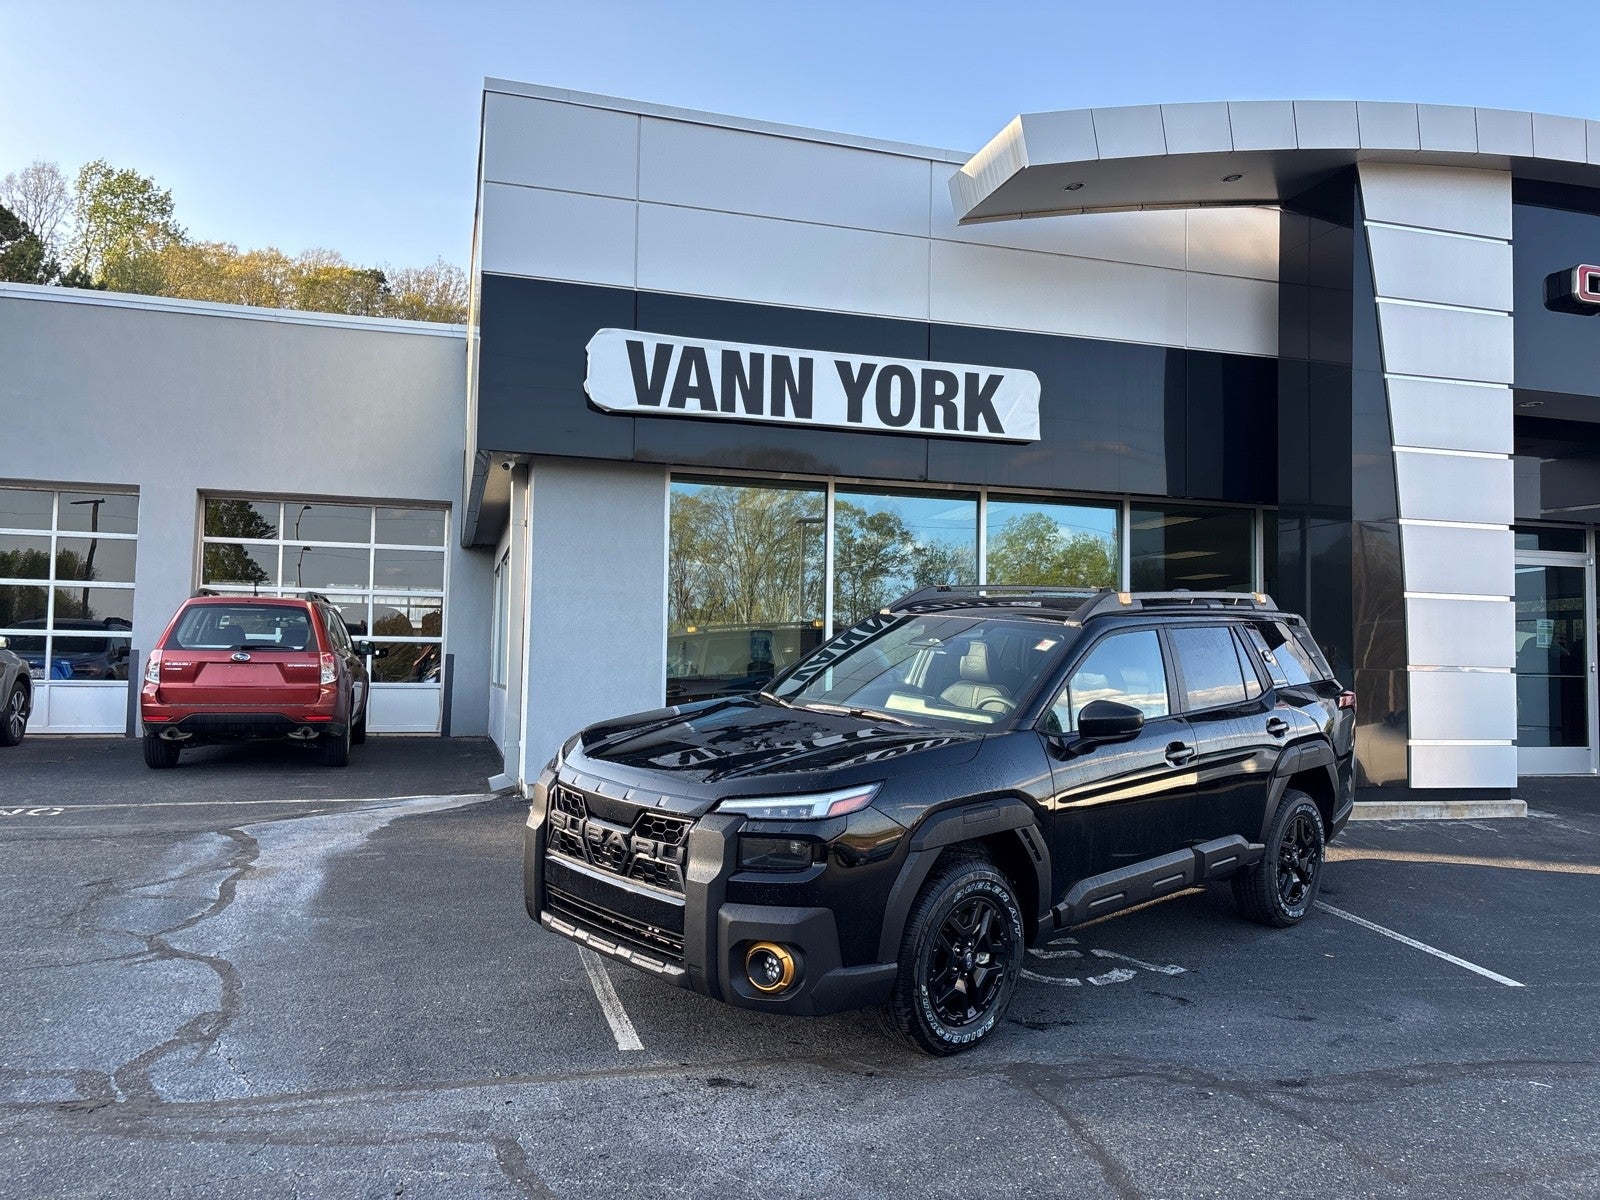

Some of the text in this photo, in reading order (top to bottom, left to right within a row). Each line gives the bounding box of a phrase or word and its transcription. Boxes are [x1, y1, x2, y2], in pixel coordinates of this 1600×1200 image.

[626, 340, 1005, 434] VANN YORK
[549, 809, 686, 865] SUBARU
